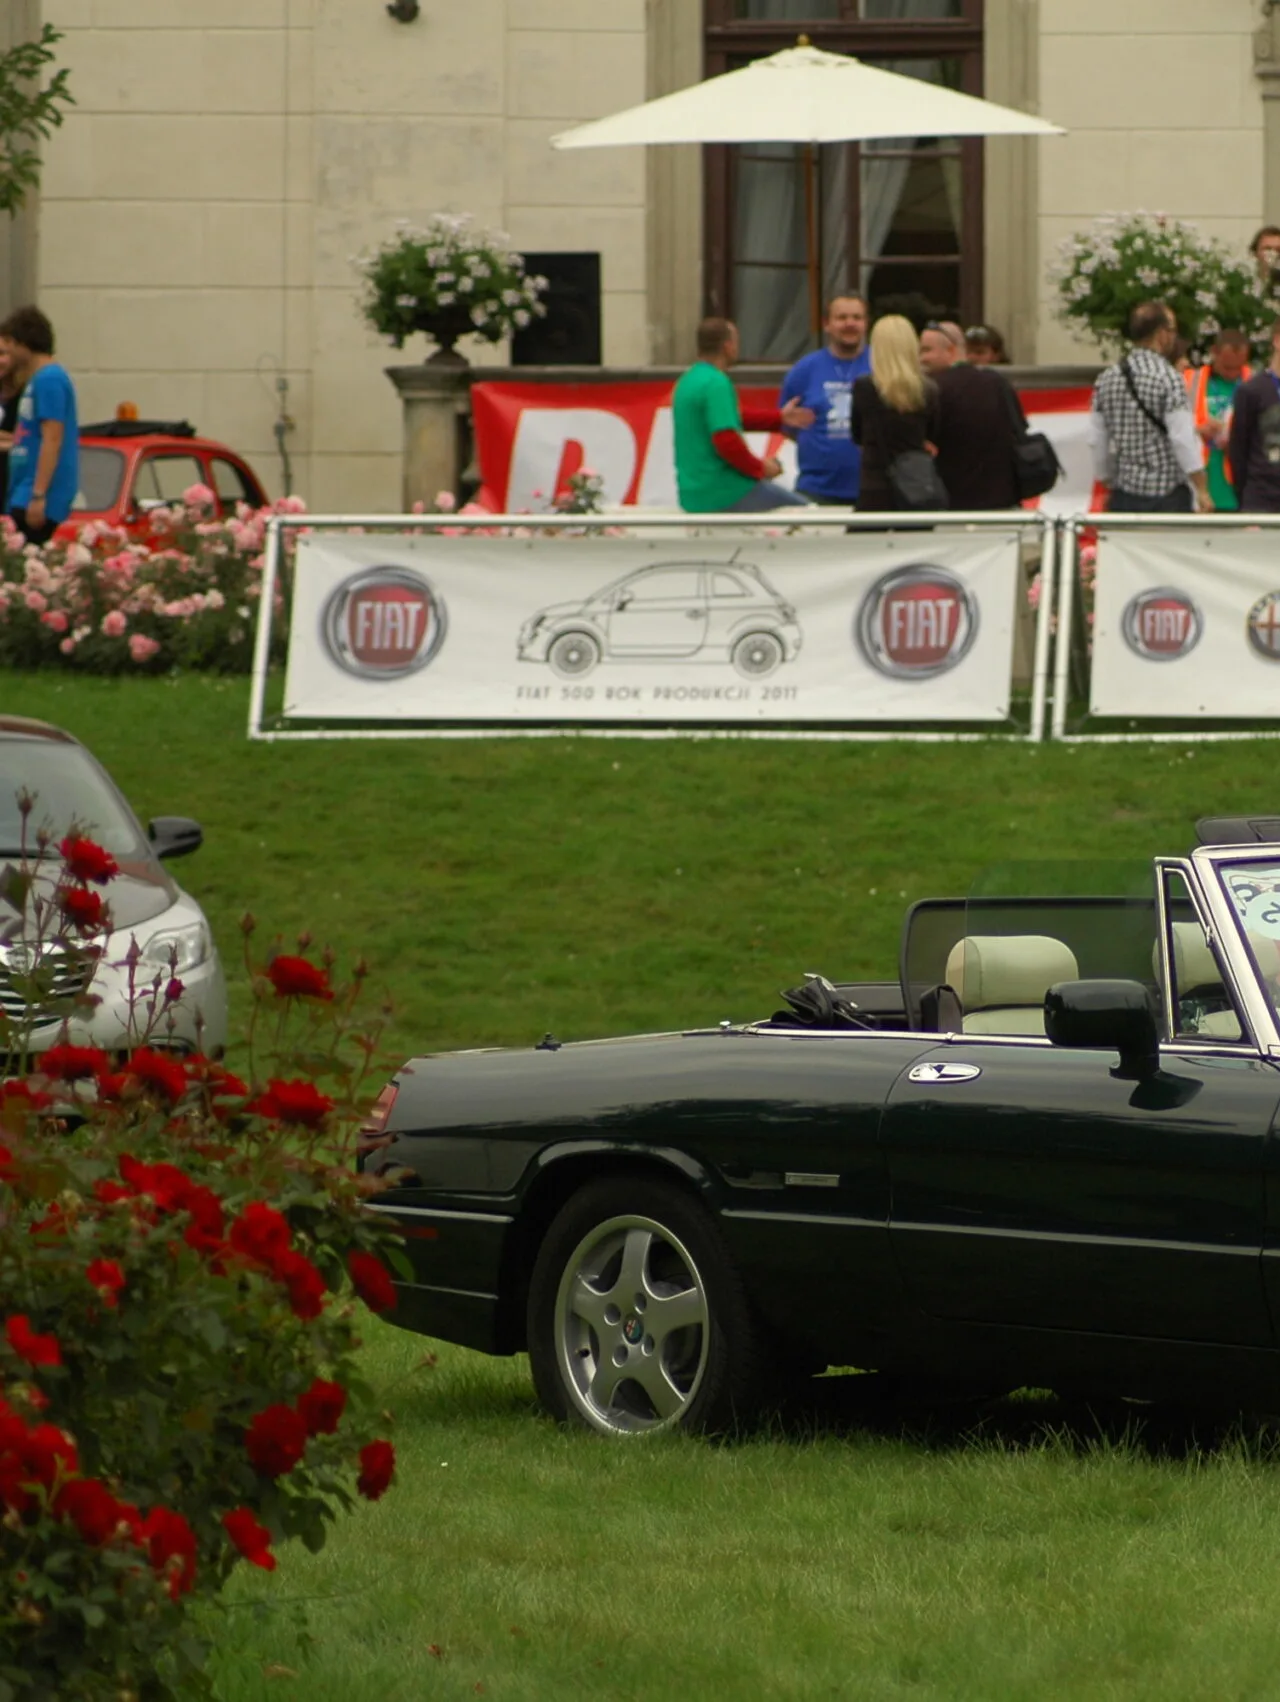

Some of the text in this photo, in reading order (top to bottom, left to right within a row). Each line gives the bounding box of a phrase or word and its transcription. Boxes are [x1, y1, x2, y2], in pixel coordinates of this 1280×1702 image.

[356, 601, 422, 649] FIAT
[890, 599, 954, 649] FIAT
[1144, 608, 1188, 641] FIAT
[516, 686, 798, 700] FIAT 500 ROK PRODUKCJI 2011
